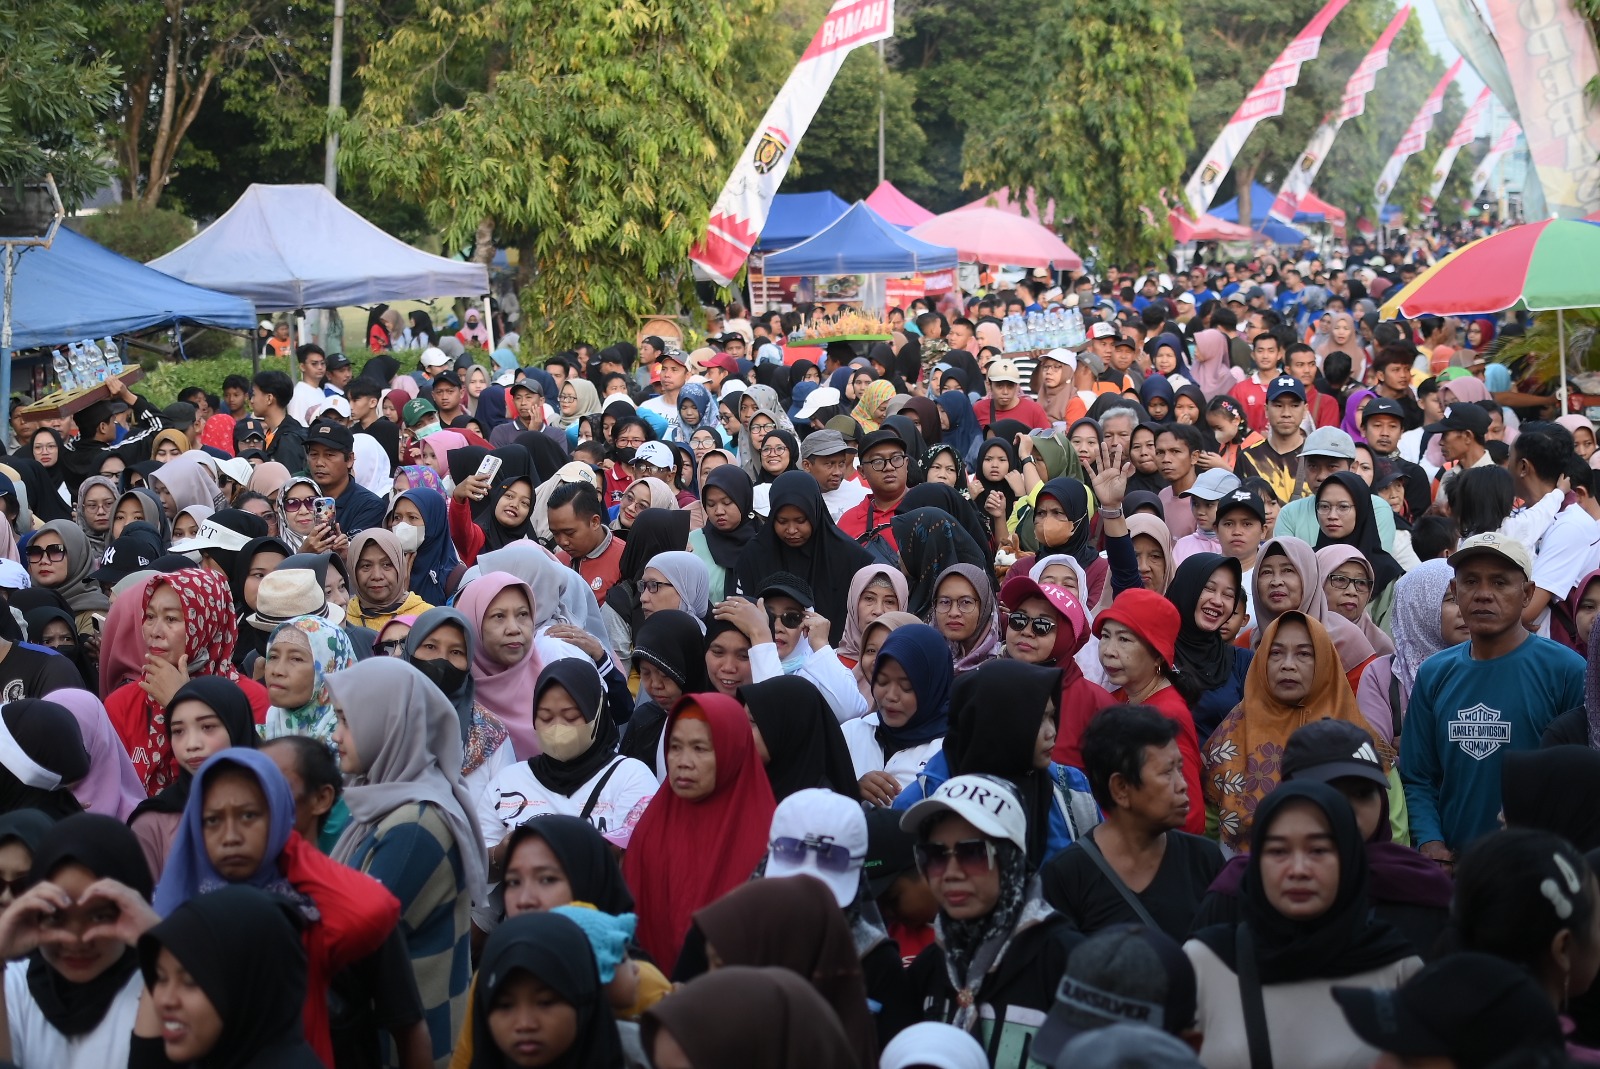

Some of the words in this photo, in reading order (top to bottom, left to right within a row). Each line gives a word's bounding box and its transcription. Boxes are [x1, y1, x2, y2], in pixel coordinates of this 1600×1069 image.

[821, 2, 885, 48] RAMAH
[101, 546, 116, 566] NY
[1464, 708, 1494, 722] MOTOR
[1452, 724, 1507, 739] HARLEY-DAVIDSON
[1464, 740, 1493, 755] COMPANY
[943, 782, 1012, 817] ORT
